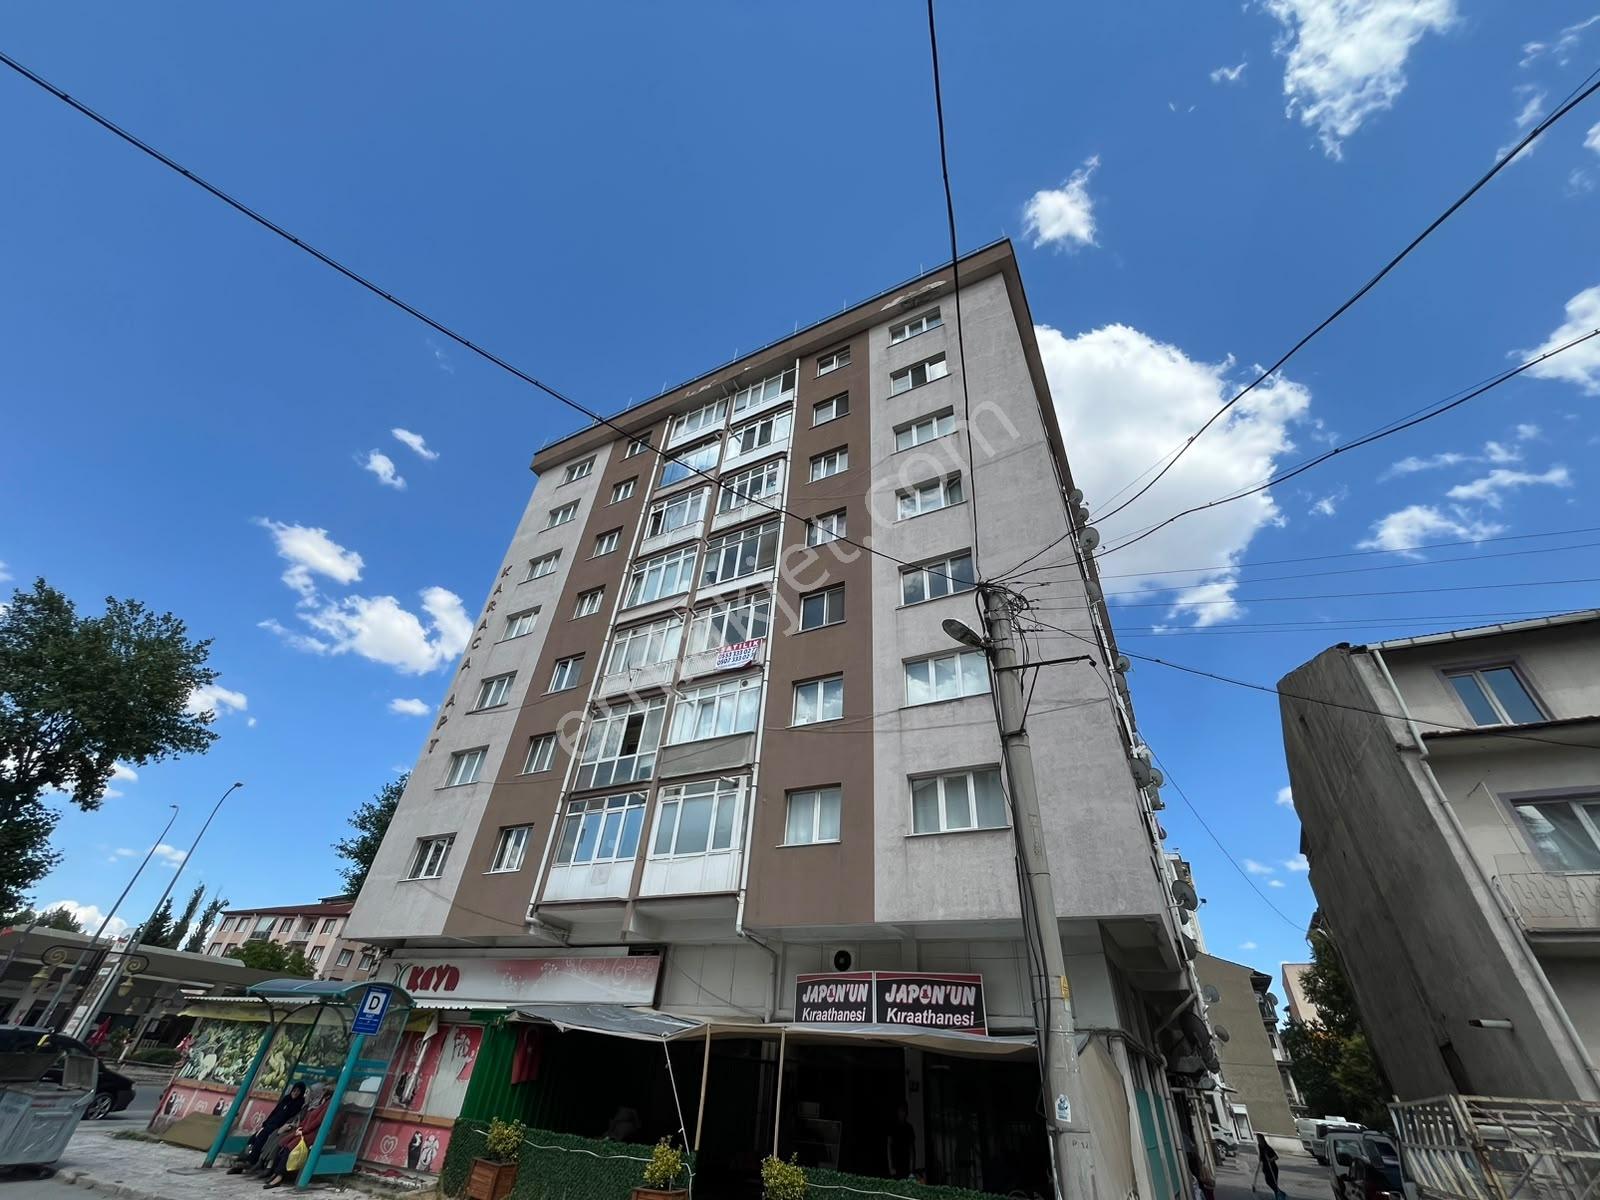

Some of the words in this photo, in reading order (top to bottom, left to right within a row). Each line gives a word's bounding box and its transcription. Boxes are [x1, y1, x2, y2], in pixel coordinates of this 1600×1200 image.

[461, 565, 512, 671] KARACA
[721, 640, 759, 652] SATILIK
[429, 693, 455, 754] APT
[368, 995, 381, 1010] D
[802, 984, 868, 1003] JAPON'UN
[885, 984, 976, 1006] JAPON'UN
[802, 1007, 866, 1022] Kıraathanesi
[886, 1007, 974, 1026] Kıraathanesi
